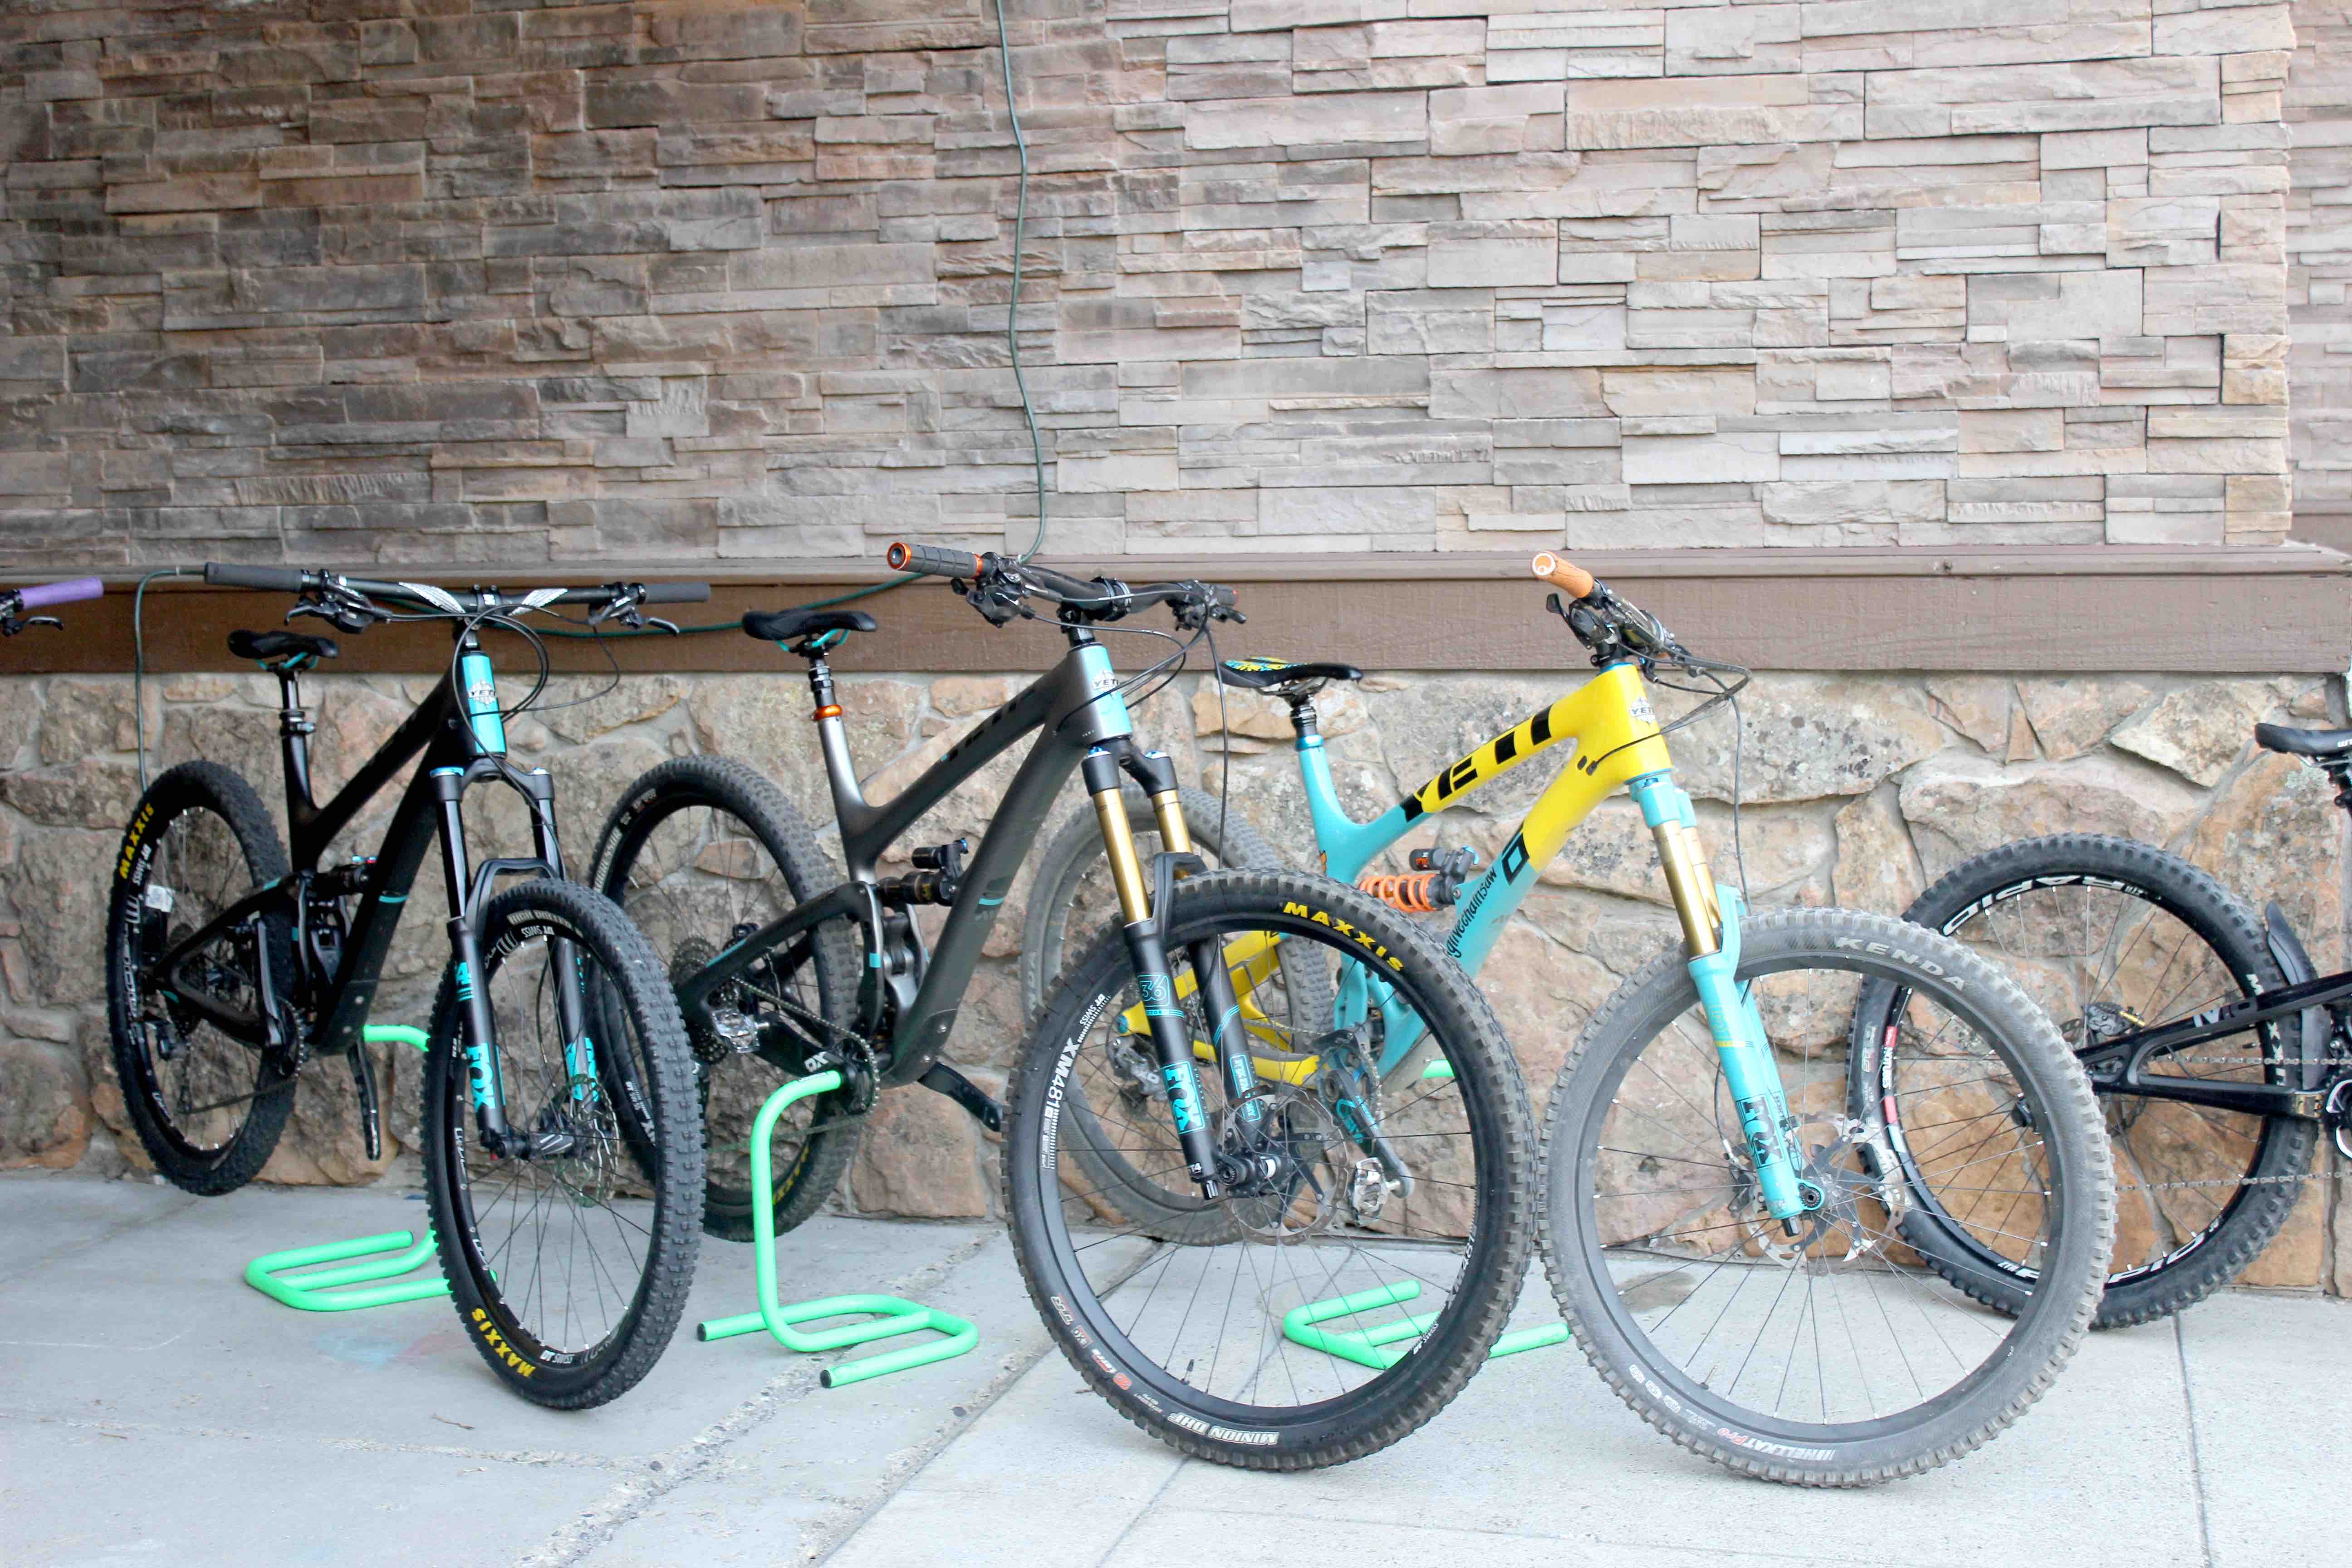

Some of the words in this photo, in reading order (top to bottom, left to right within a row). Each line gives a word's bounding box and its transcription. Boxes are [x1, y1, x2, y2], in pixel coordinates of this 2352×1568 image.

[471, 689, 496, 698] YETI
[1094, 678, 1119, 687] YETI
[1632, 707, 1654, 715] YETI
[119, 802, 155, 880] MAXXIS
[506, 910, 534, 926] HIGH
[521, 925, 543, 938] SWISS
[1944, 875, 2127, 936] RAPID
[1283, 902, 1404, 972] MAXXIS
[1836, 937, 1965, 991] KENDA
[1079, 1003, 1097, 1027] SWISS
[1094, 993, 1106, 1008] DT
[2245, 973, 2284, 1086] MXXI
[466, 1042, 496, 1114] FOX
[1046, 1037, 1079, 1109] XM481
[1165, 1063, 1202, 1132] FOX
[1743, 1095, 1784, 1165] FOX
[2015, 1232, 2206, 1284] RPID
[471, 1308, 536, 1378] MAXXIS
[1168, 1411, 1209, 1435] DHF
[1208, 1425, 1279, 1446] MINION
